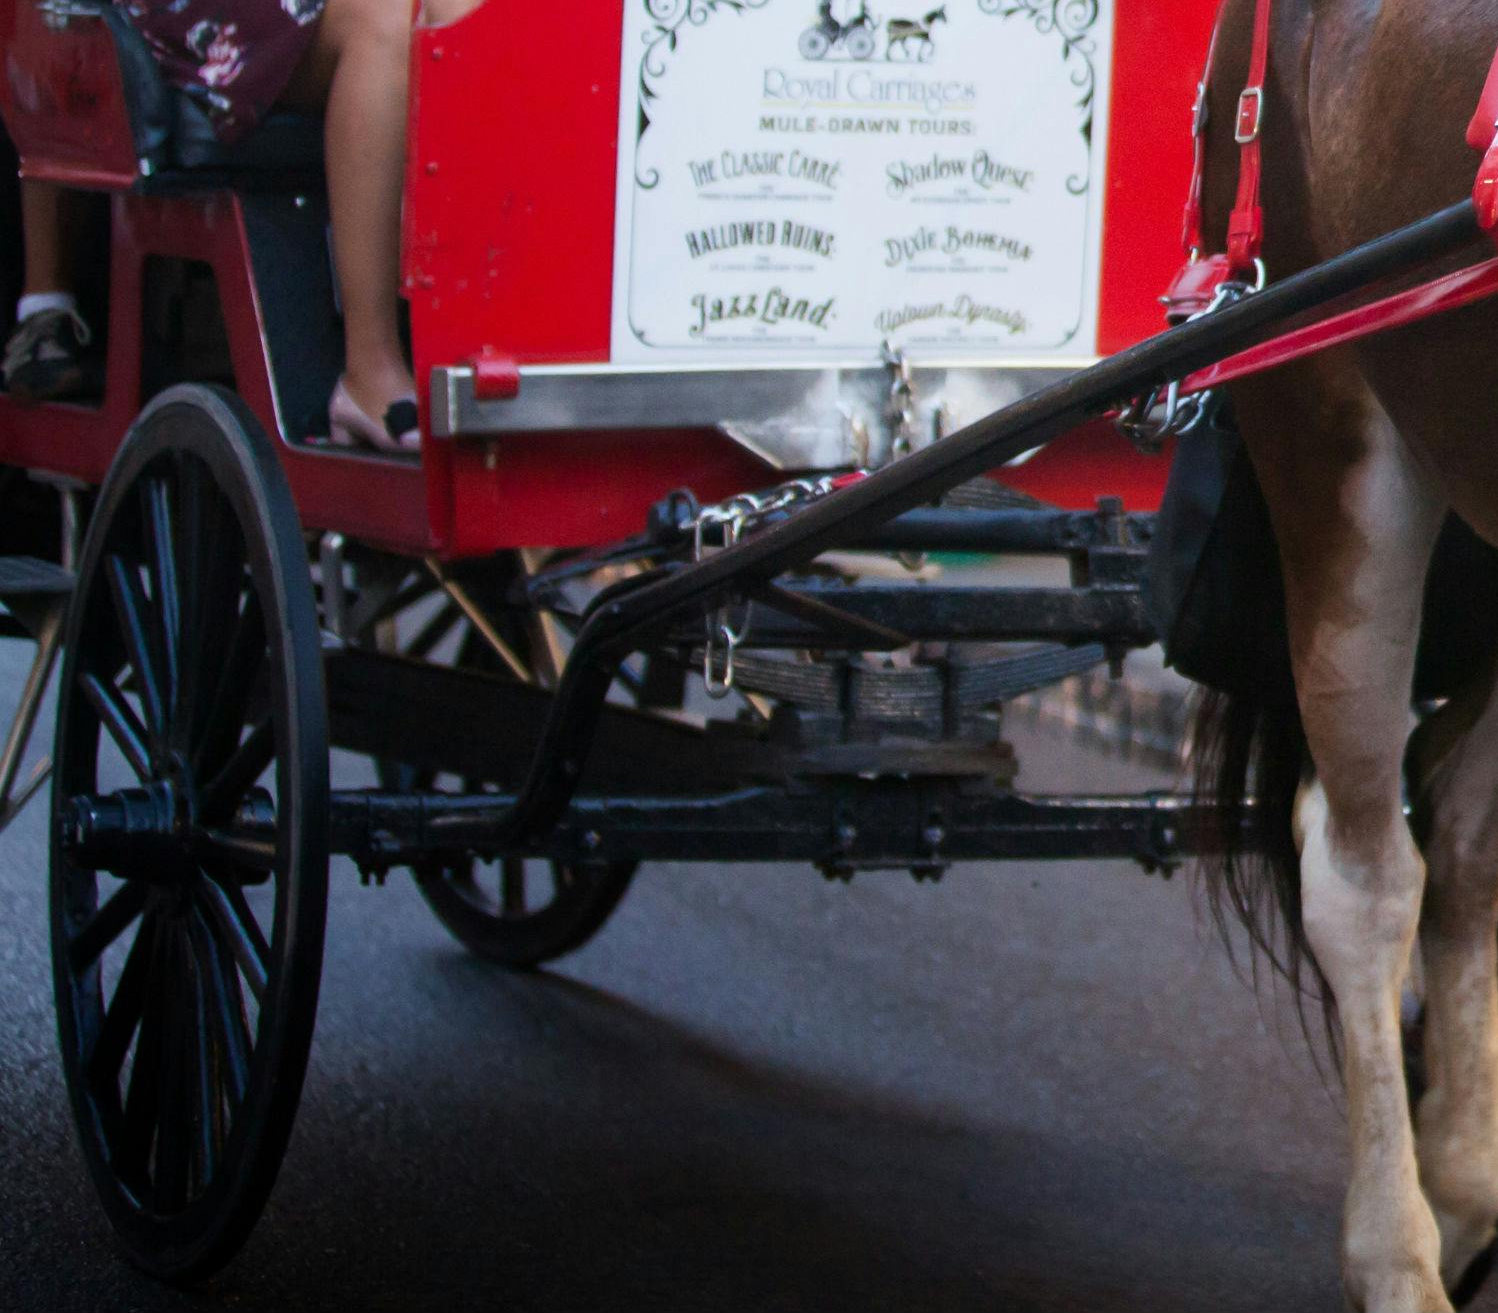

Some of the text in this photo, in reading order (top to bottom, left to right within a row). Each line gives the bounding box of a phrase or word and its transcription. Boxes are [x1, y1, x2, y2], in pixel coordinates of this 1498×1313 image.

[762, 67, 976, 114] Royal Carriages
[759, 116, 899, 133] MULE-DRAWN
[687, 158, 718, 187] THE
[721, 149, 784, 178] CLASSIC
[885, 152, 967, 199] Shadow
[685, 221, 776, 259] HALLOWED
[689, 292, 757, 337] Jazz
